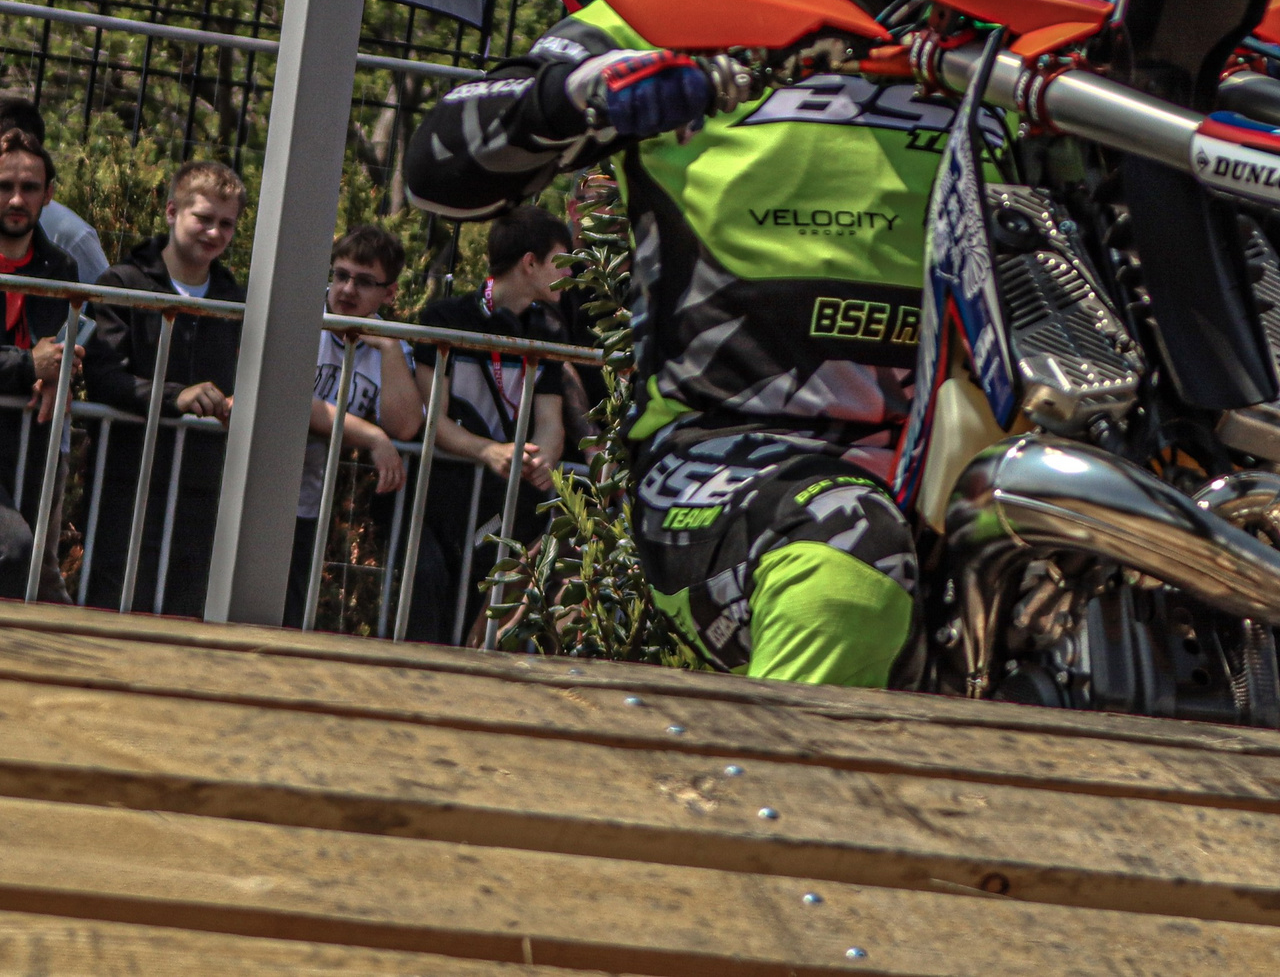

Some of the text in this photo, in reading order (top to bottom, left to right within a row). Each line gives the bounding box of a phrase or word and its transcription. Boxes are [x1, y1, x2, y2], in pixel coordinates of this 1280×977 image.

[749, 209, 900, 231] VELOCITY
[799, 229, 857, 237] GROUP
[810, 296, 891, 342] BSE
[794, 478, 834, 505] BSE
[661, 504, 724, 530] TEAM
